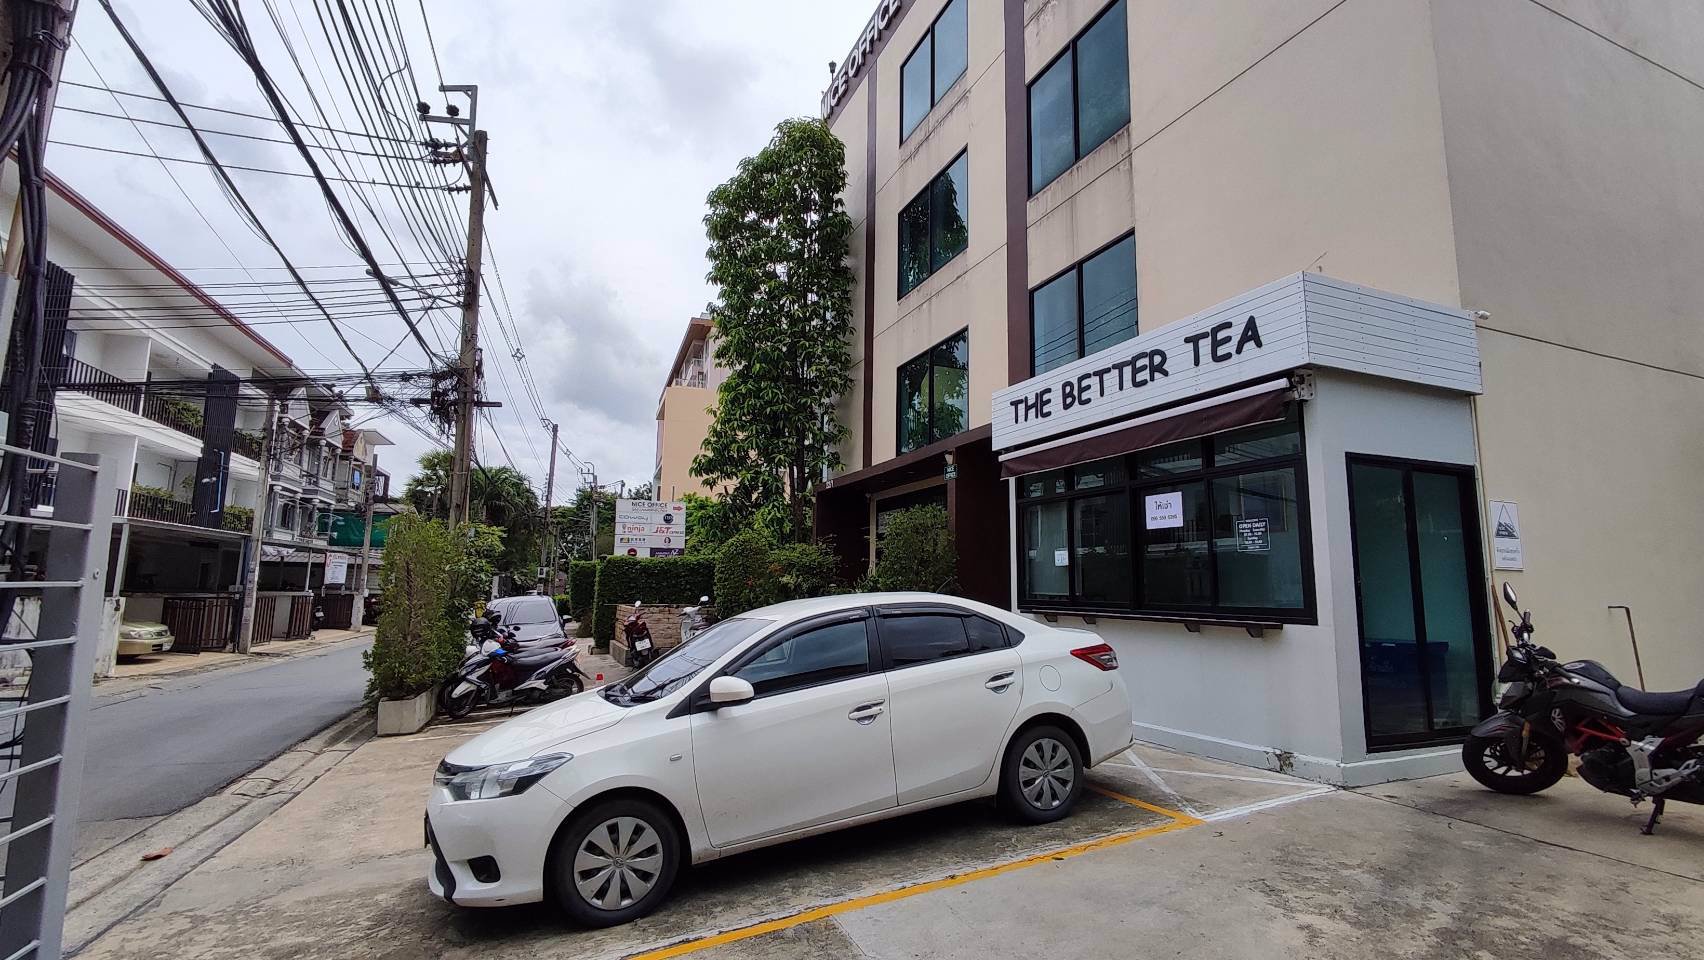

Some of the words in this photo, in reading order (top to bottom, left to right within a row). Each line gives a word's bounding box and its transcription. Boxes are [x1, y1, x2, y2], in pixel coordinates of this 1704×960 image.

[821, 66, 848, 120] NICE
[1009, 387, 1052, 425] THE
[1061, 348, 1169, 411] BETTER
[1183, 315, 1263, 367] TEA
[627, 524, 645, 533] ninja
[652, 526, 672, 534] J&T
